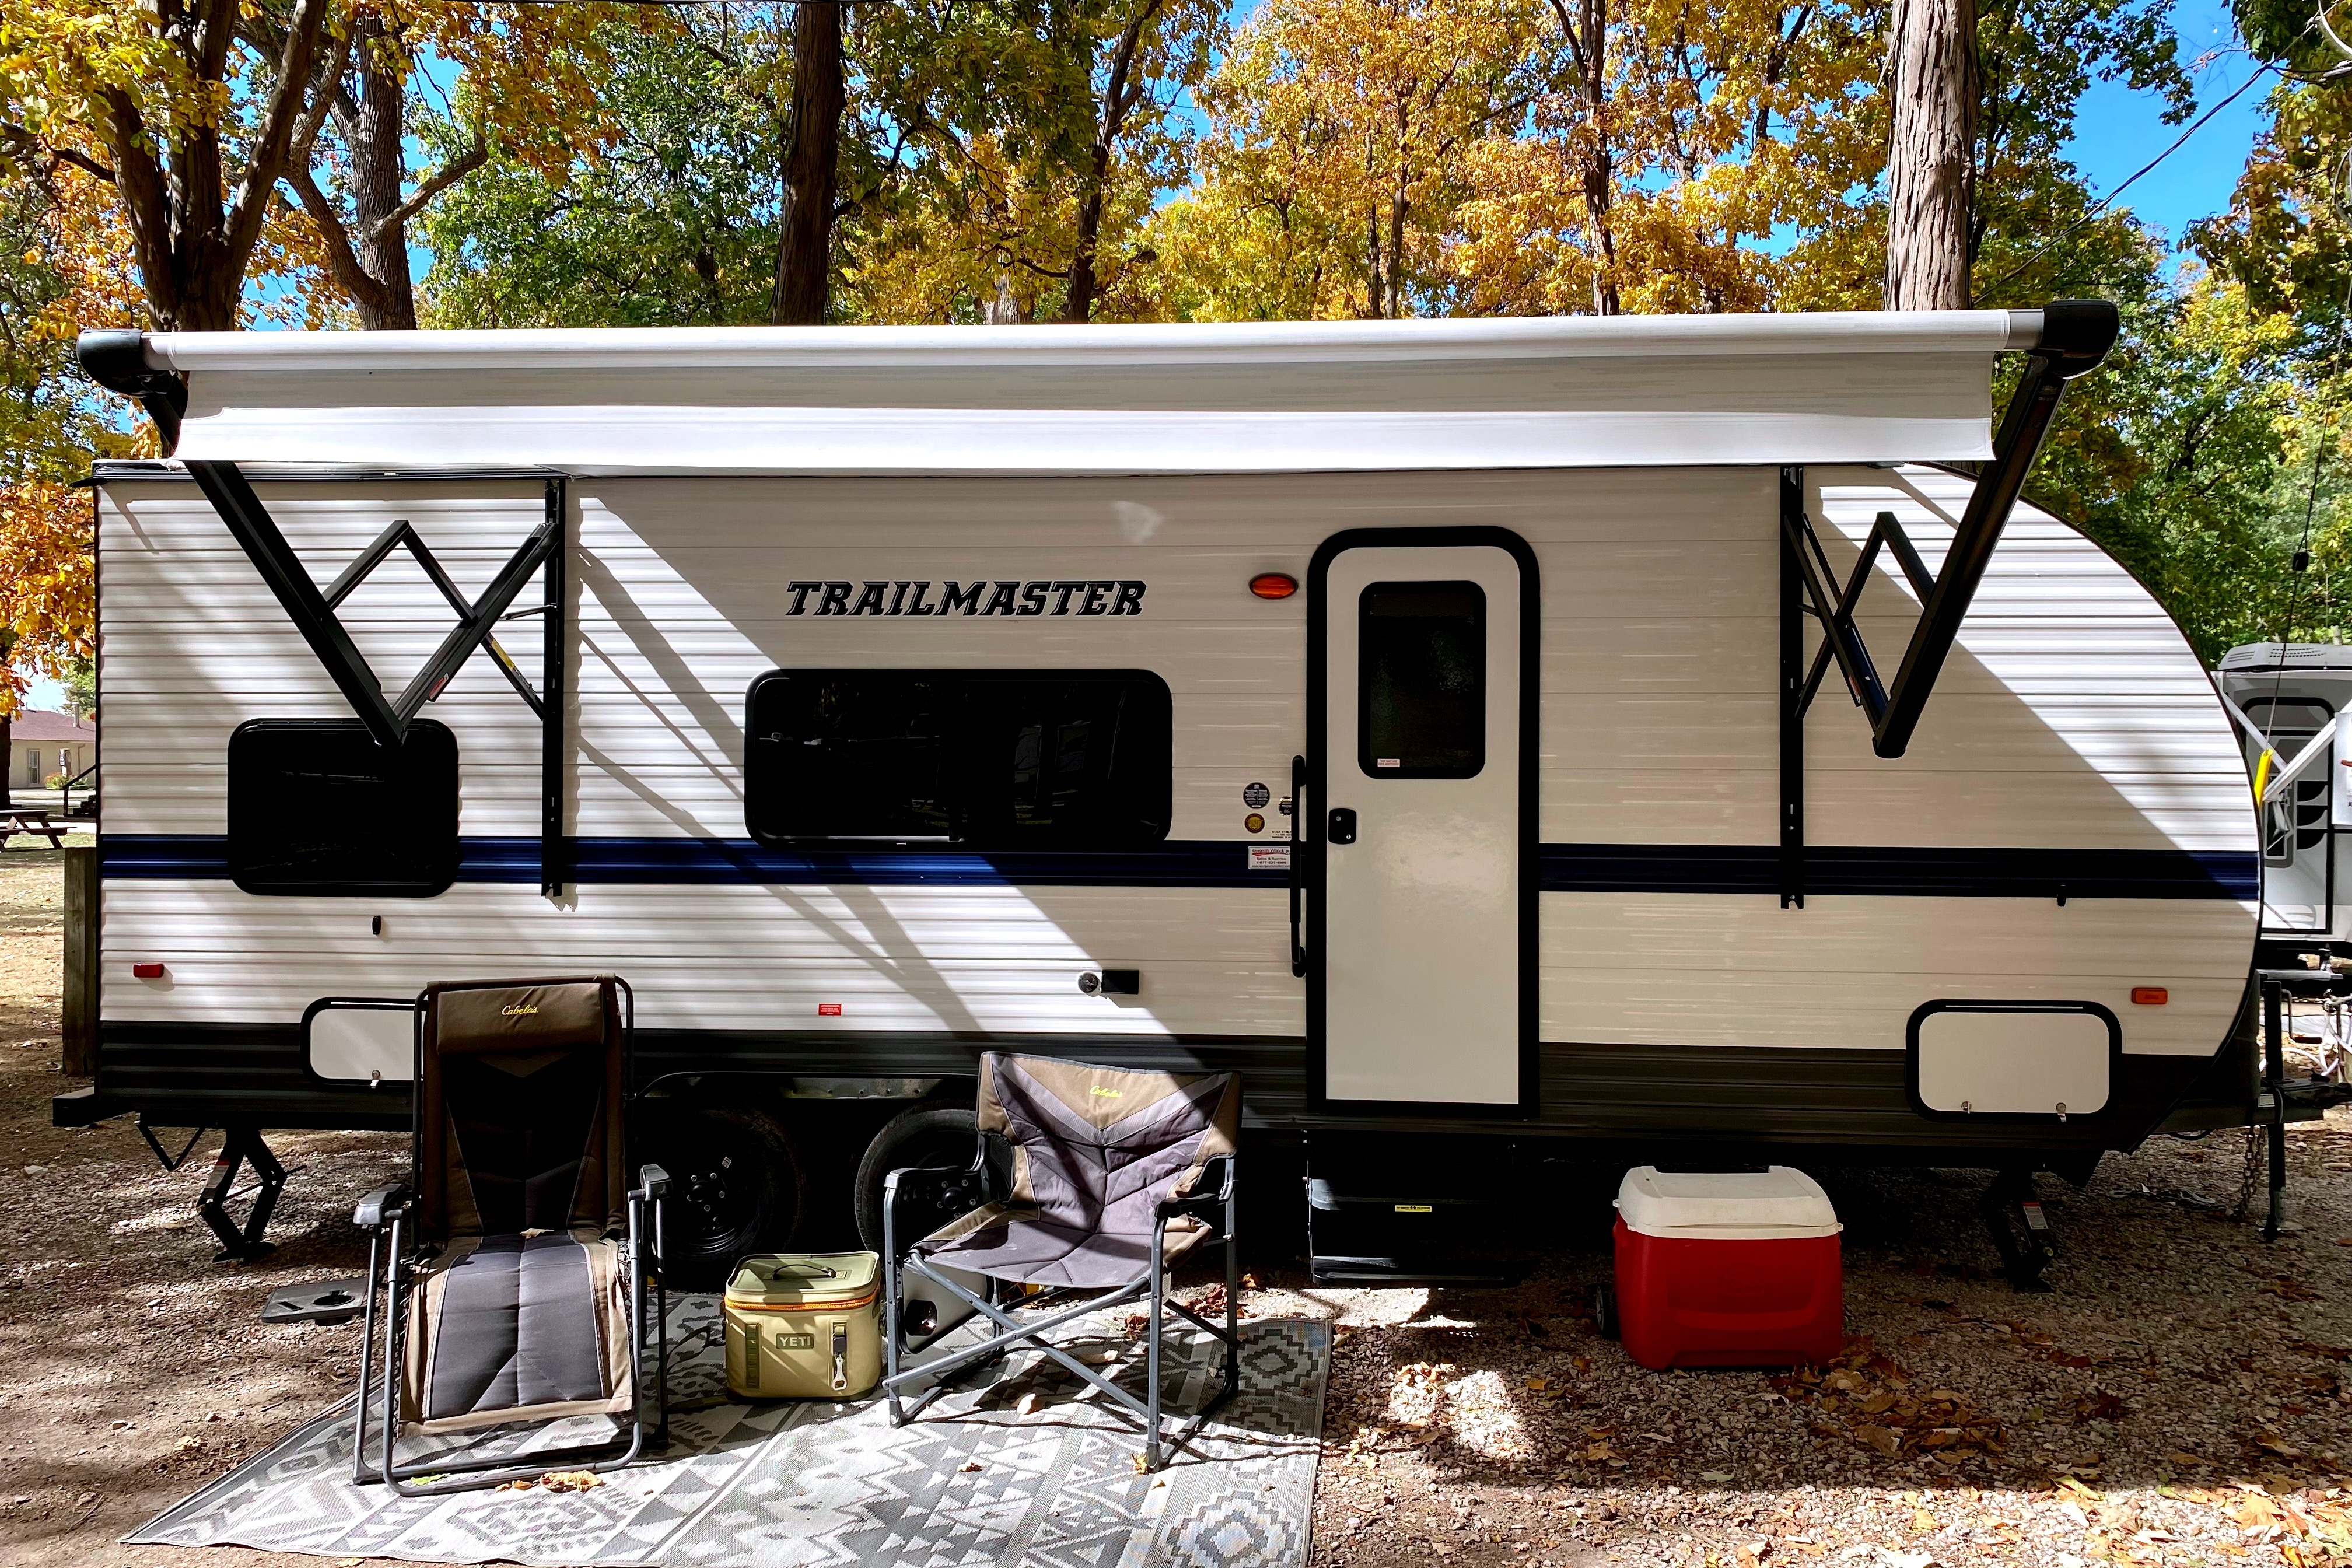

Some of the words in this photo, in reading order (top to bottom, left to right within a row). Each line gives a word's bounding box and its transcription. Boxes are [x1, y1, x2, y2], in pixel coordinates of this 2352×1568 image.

[785, 580, 1147, 617] TRAILMASTER
[502, 1005, 538, 1016] Cabela's
[779, 1336, 811, 1346] YETI
